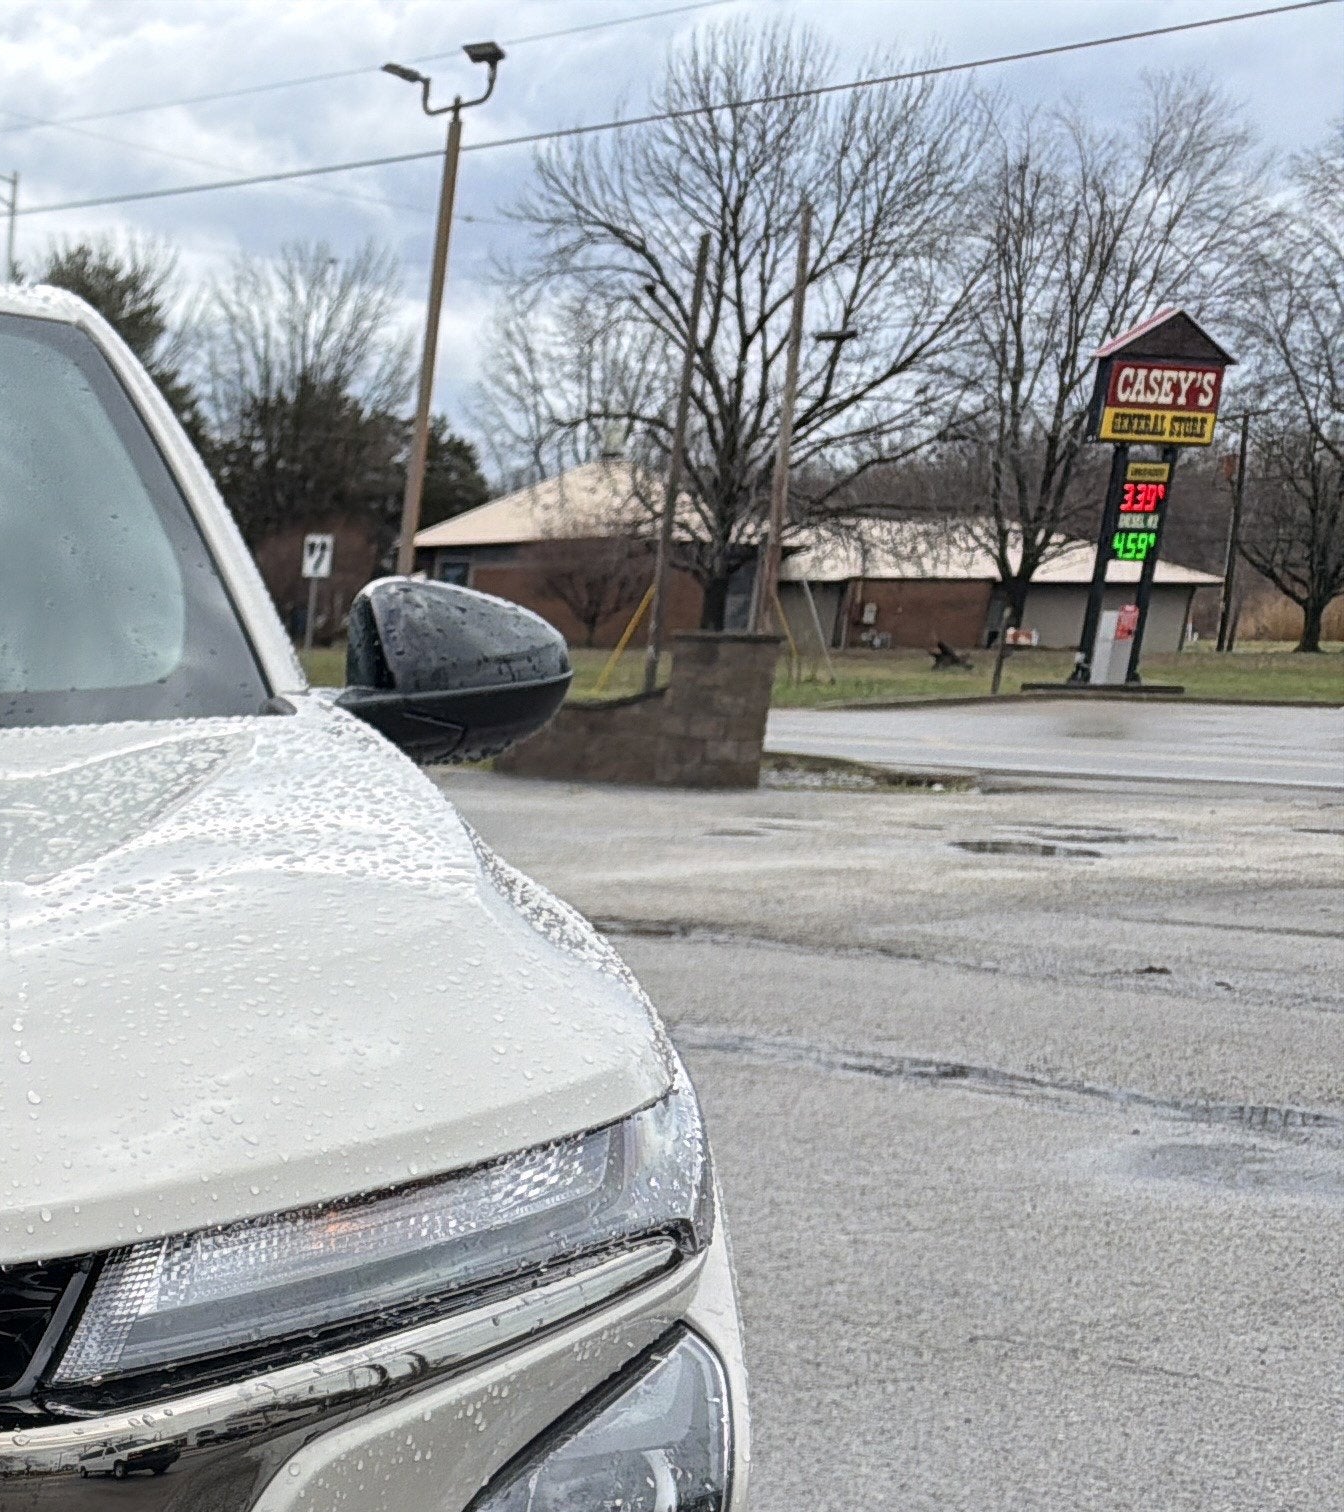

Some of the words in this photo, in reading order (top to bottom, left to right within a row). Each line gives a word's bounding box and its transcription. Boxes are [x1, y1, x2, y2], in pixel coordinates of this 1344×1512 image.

[1116, 366, 1217, 408] CASEY'S
[1112, 411, 1166, 436] GENERAL
[1168, 416, 1208, 438] STORE
